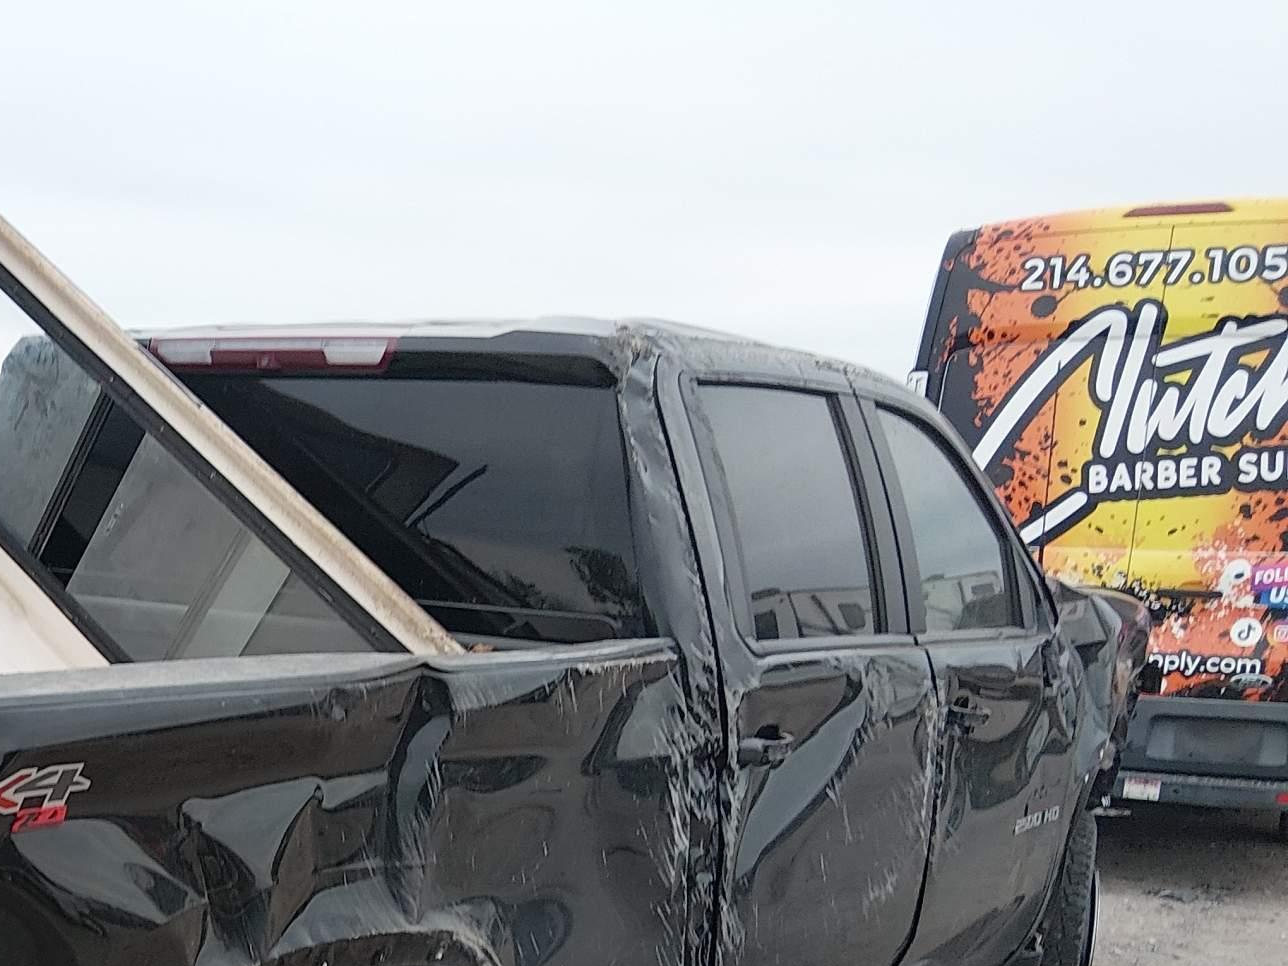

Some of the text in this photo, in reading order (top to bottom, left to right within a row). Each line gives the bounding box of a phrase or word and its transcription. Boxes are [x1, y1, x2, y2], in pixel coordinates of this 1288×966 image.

[1020, 246, 1288, 291] 214.677.105
[1088, 450, 1288, 494] BARBER SU
